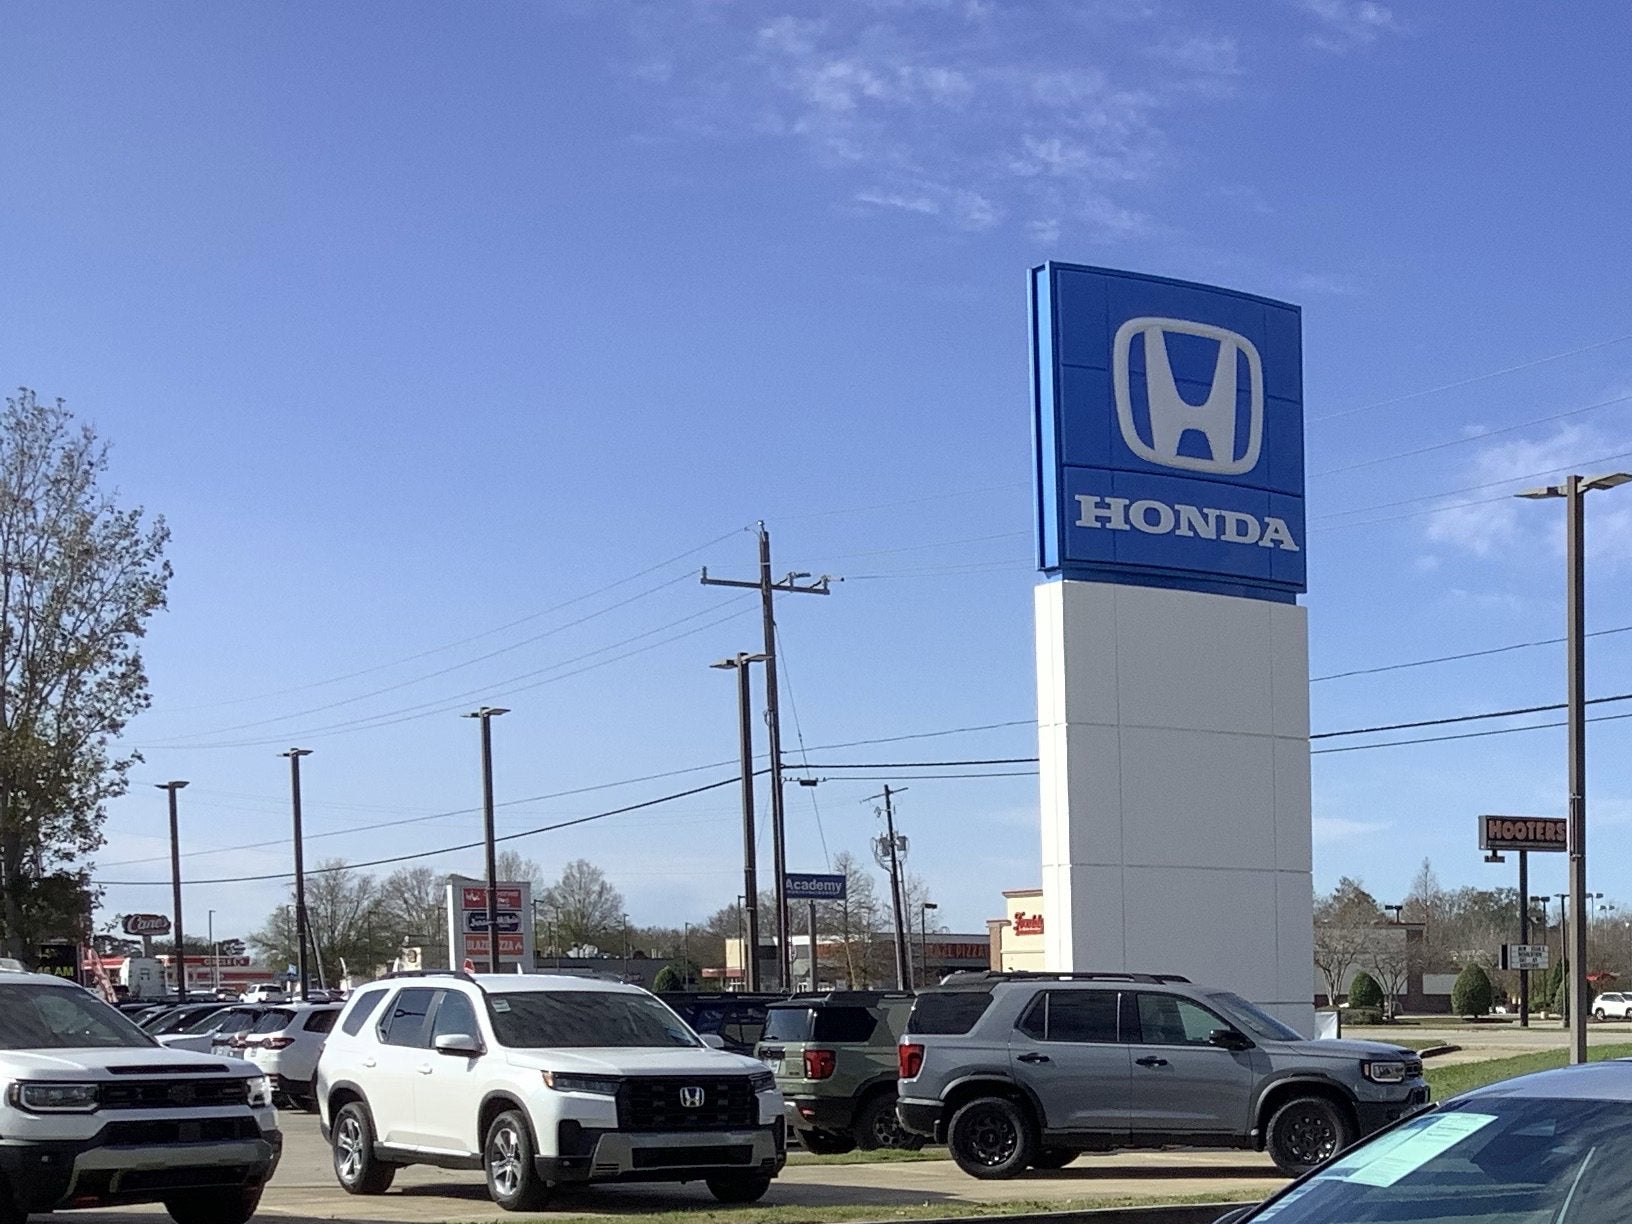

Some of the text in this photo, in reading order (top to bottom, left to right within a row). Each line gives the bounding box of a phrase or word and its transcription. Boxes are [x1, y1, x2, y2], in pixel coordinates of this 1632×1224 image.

[1074, 494, 1299, 552] HONDA
[1488, 820, 1565, 842] HOOTERS
[786, 878, 842, 894] Academy
[127, 914, 171, 933] Cane's
